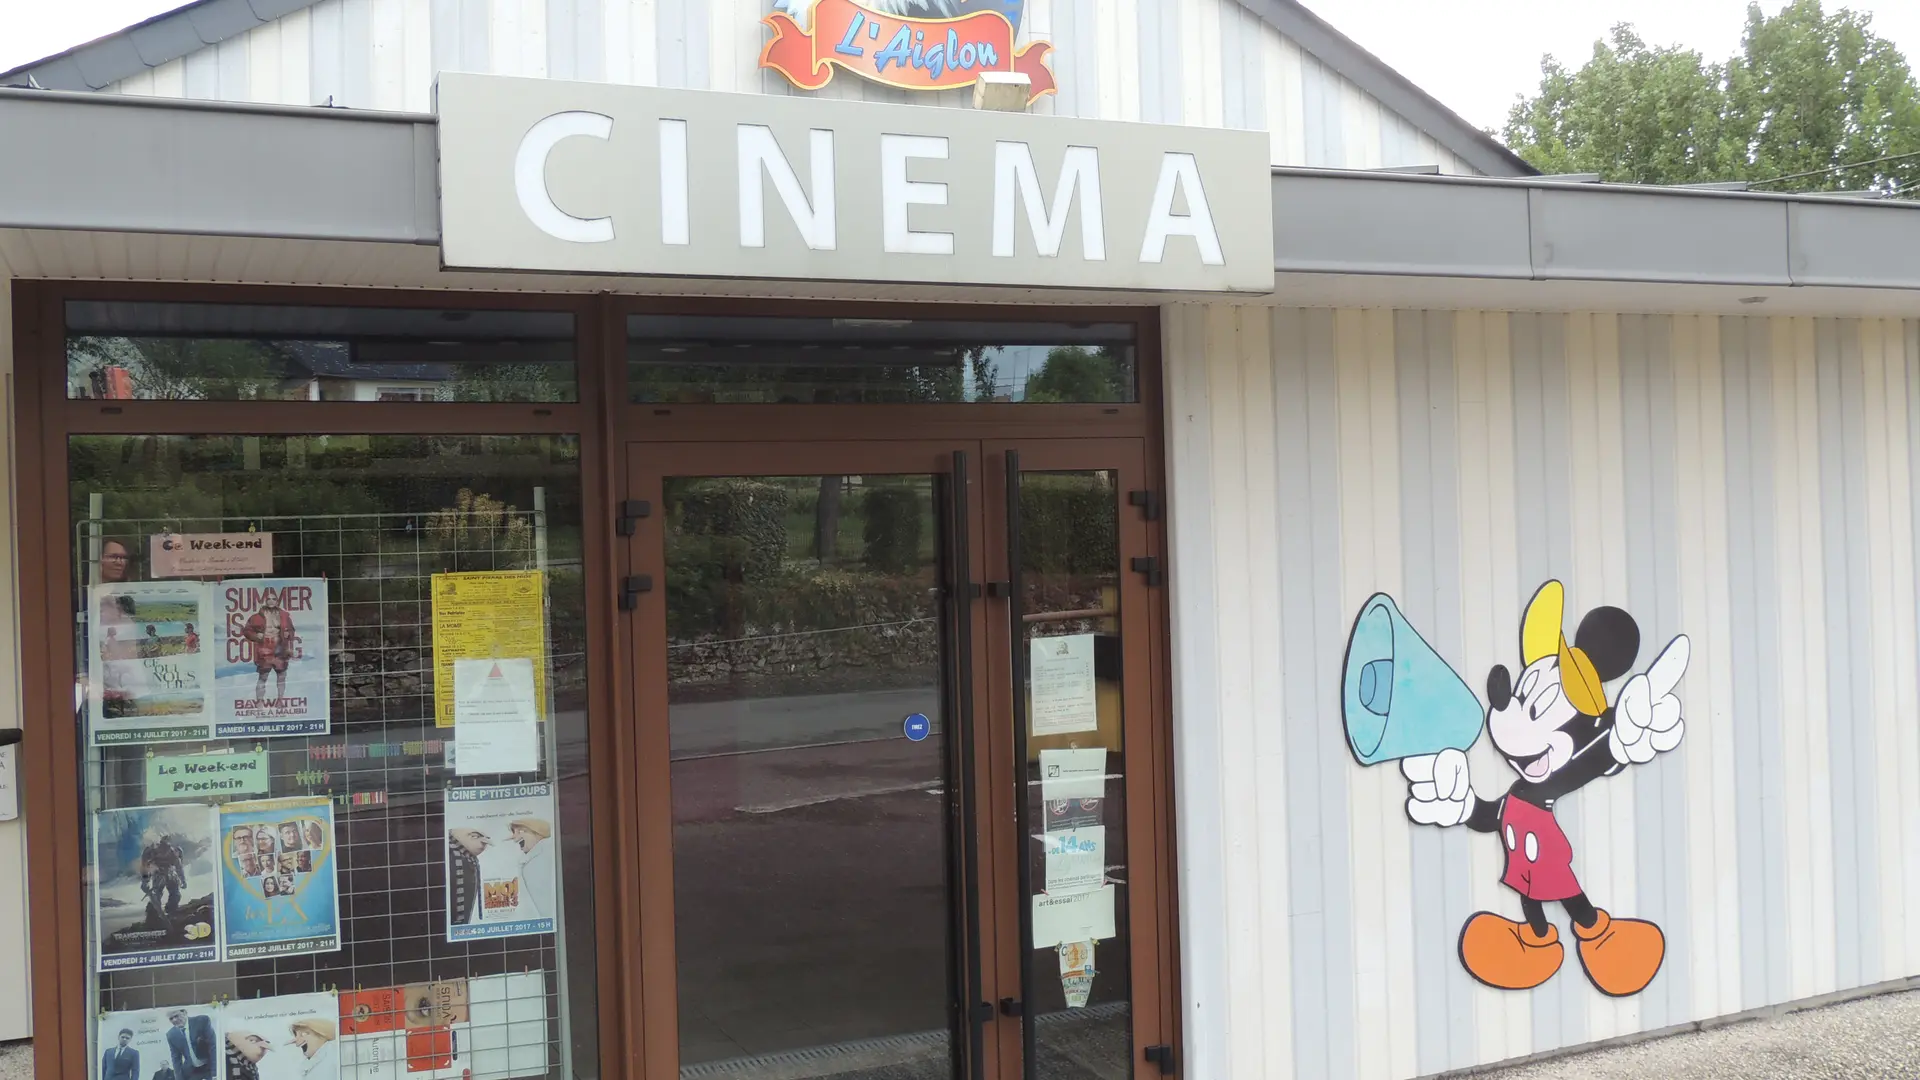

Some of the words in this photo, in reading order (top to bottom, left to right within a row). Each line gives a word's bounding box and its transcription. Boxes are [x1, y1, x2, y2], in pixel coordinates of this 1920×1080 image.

[834, 11, 998, 80] L'Aiglon
[514, 110, 1226, 267] CINEMA
[162, 539, 183, 551] Ce
[190, 537, 262, 551] Week-end
[225, 586, 313, 613] SUMMER
[226, 613, 246, 639] IS
[227, 637, 303, 664] COG
[234, 697, 308, 710] BAYWATCH
[275, 708, 308, 716] MALIBU
[96, 732, 132, 741] VENDREDI
[142, 730, 170, 739] JUILLET
[171, 729, 187, 737] 2017
[217, 725, 246, 734] SAMEDI
[257, 724, 285, 732] JUILLET
[286, 723, 303, 731] 2017
[158, 763, 177, 776] Le
[184, 759, 257, 774] Week-end
[172, 777, 244, 792] Prochain
[452, 789, 477, 801] CINE
[479, 787, 511, 800] P'TITS
[513, 785, 547, 797] LOUPS
[1059, 835, 1078, 853] 14
[1078, 839, 1097, 852] ANS
[1038, 893, 1072, 908] art&essai
[184, 921, 212, 941] 3D
[487, 924, 514, 933] JUILLET
[514, 923, 531, 931] 2017
[228, 946, 257, 956] SAMEDI
[258, 945, 267, 953] 22
[268, 942, 296, 952] JUILLET
[297, 941, 314, 949] 2017
[103, 956, 138, 966] VENDREDI
[139, 955, 147, 964] 21
[148, 953, 176, 963] JUILLET
[177, 951, 194, 960] 2017
[372, 1037, 380, 1073] Automne
